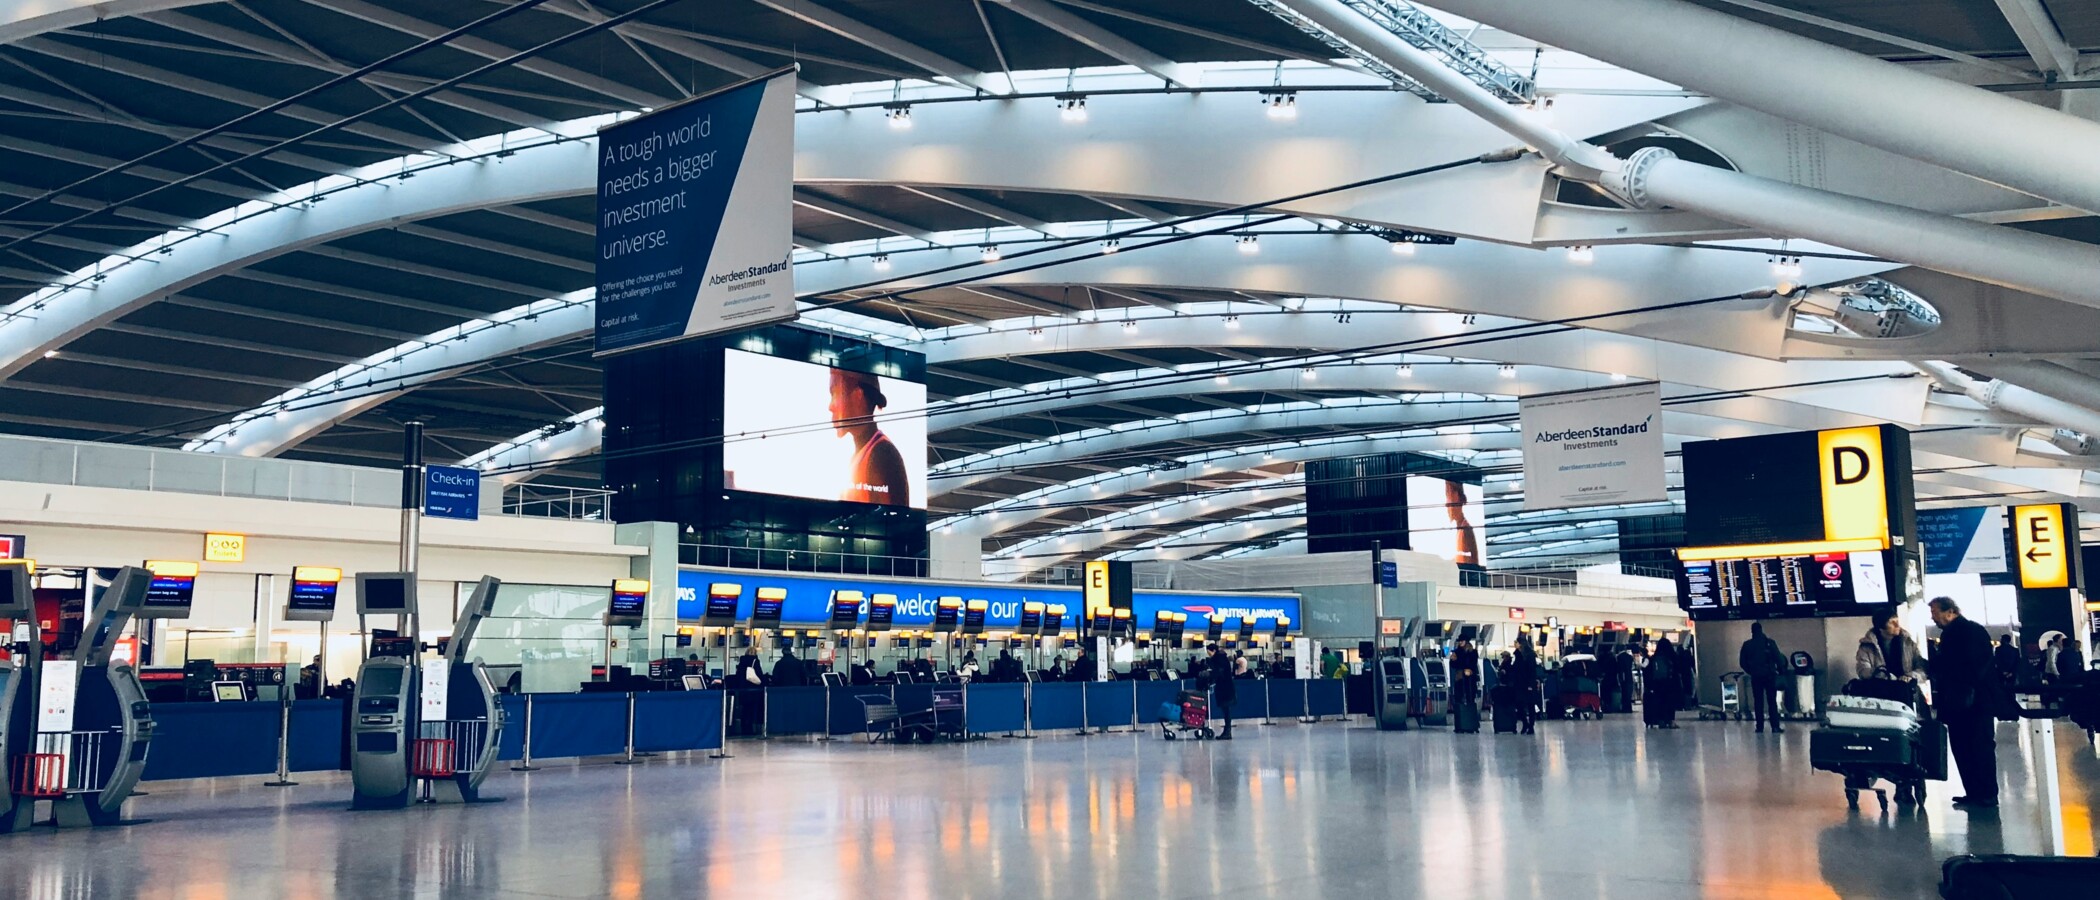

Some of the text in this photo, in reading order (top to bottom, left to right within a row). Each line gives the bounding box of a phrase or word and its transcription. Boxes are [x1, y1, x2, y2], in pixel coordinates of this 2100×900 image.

[604, 113, 711, 167] A tough world
[604, 150, 717, 197] needs a bigger
[604, 189, 687, 229] investment
[603, 229, 669, 259] universe.
[602, 266, 683, 292] Offering the choice you need
[708, 259, 787, 286] AberdeenStandard
[602, 280, 678, 303] for the challenges you face.
[728, 278, 766, 292] Investments
[601, 312, 640, 328] Capital at risk.
[1535, 421, 1648, 443] AberdeenStandard
[1563, 439, 1618, 451] Investments
[1832, 446, 1870, 485] D
[431, 471, 475, 487] Check-in
[863, 483, 872, 491] the
[873, 485, 889, 493] world
[2030, 517, 2050, 543] E
[1093, 569, 1103, 588] E
[991, 600, 1018, 619] our
[1217, 607, 1285, 619] BRITISH AIRWAYS
